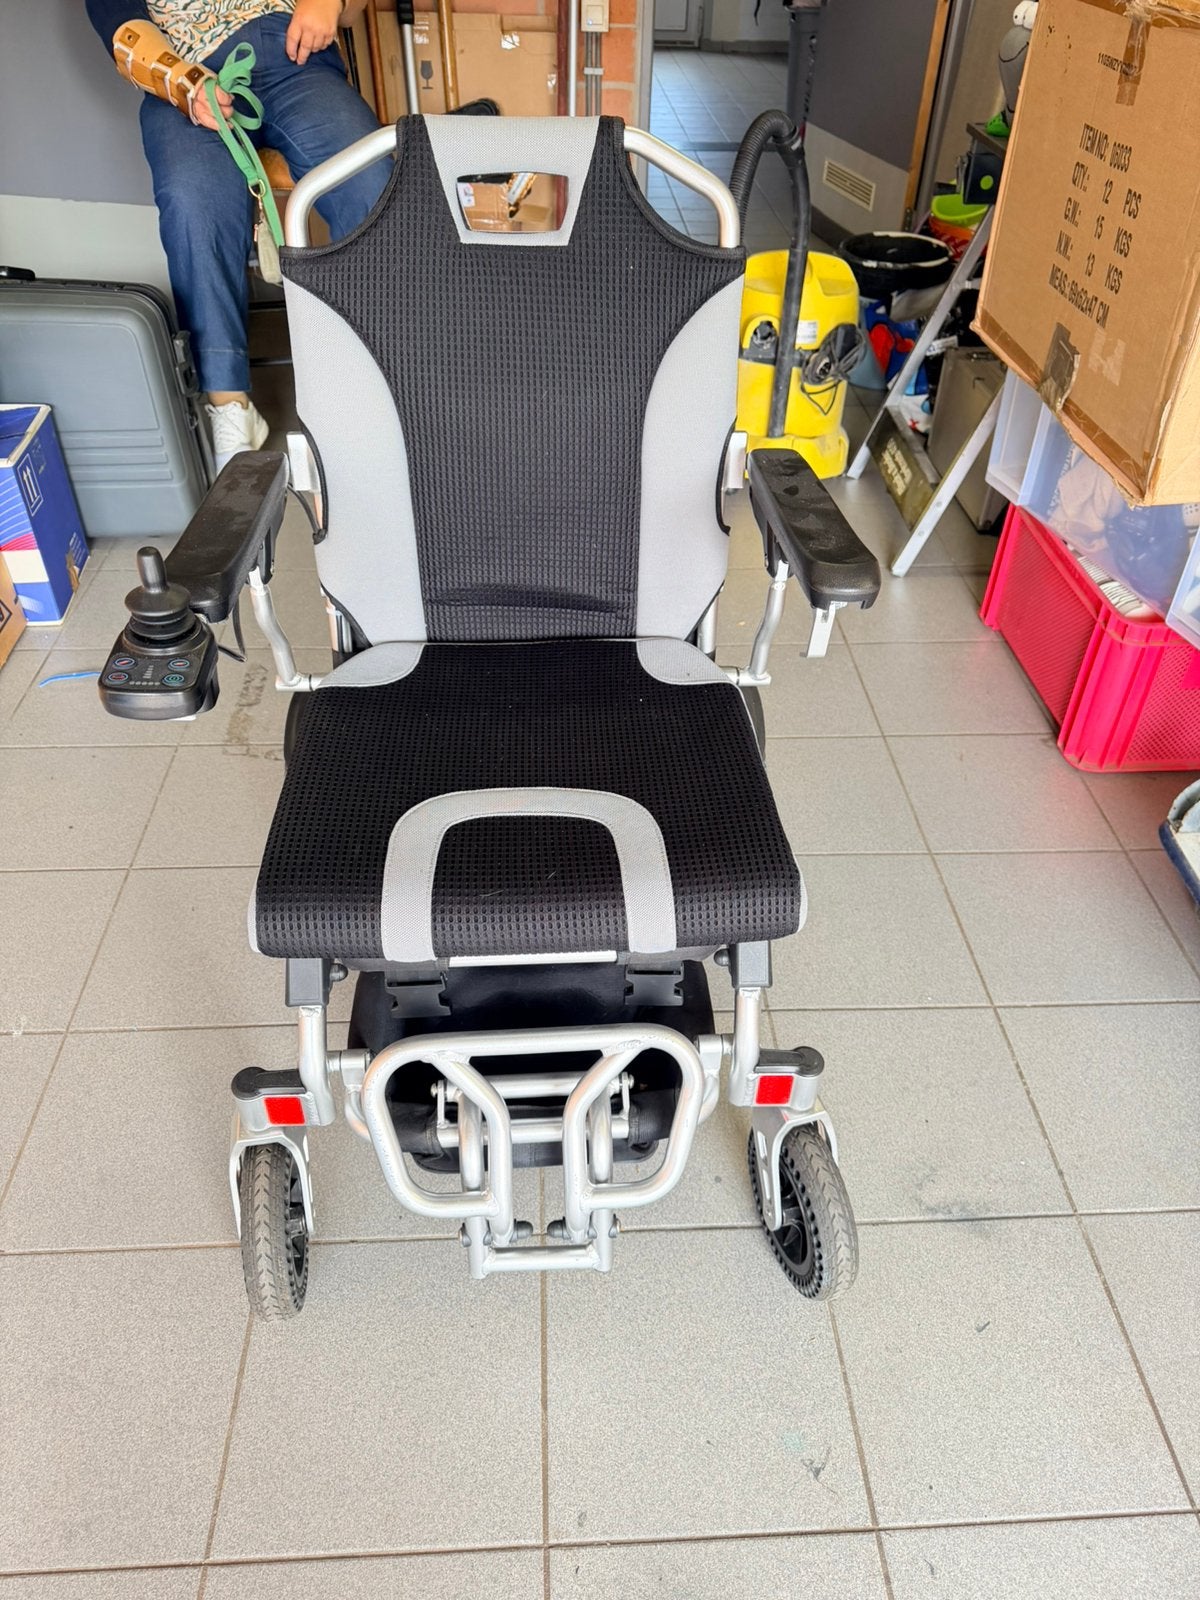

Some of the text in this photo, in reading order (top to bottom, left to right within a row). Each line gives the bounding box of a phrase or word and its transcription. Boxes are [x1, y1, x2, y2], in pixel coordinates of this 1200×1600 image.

[1079, 123, 1098, 154] ITEM
[1109, 141, 1132, 173] 06033
[1102, 178, 1113, 204] 12
[1123, 188, 1141, 219] PCS
[1094, 214, 1105, 240] 15
[1113, 226, 1132, 258] KGS
[1085, 252, 1095, 277] 13
[1105, 263, 1123, 295] KGS
[1096, 301, 1110, 329] CM
